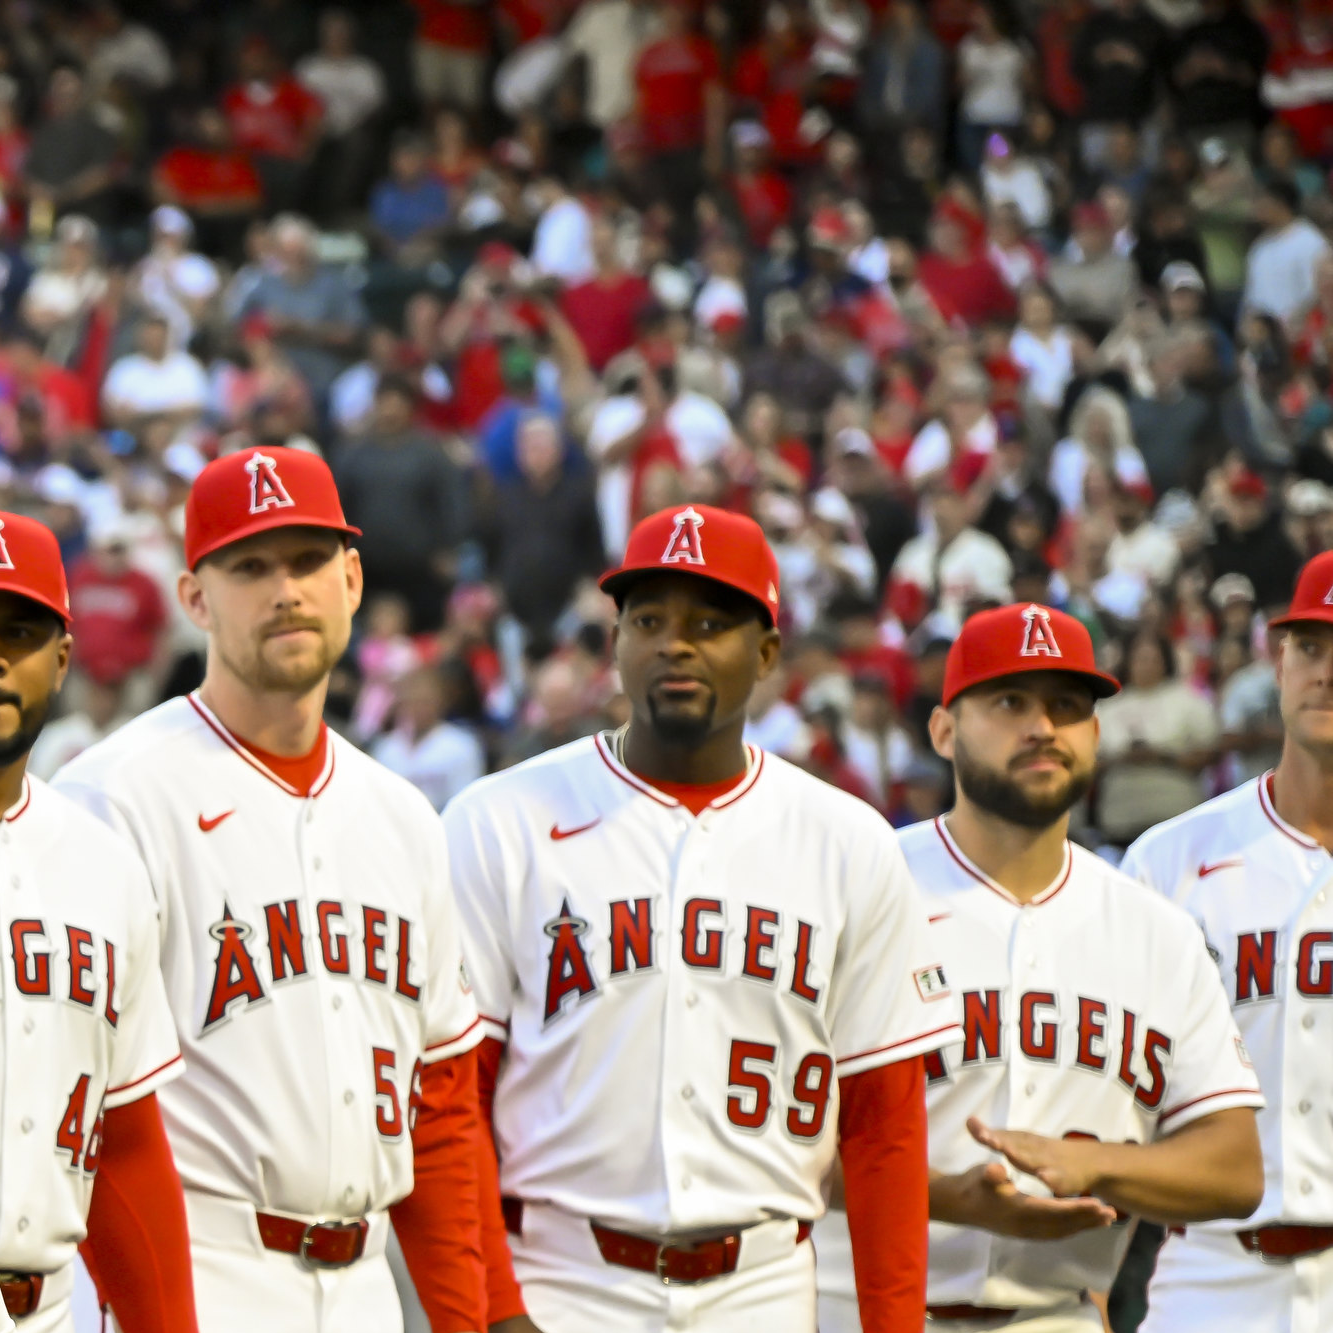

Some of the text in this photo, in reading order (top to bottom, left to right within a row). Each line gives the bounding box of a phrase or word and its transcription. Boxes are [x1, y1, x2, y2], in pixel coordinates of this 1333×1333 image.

[244, 451, 296, 515] A
[660, 506, 706, 567] A
[1020, 603, 1063, 659] A
[925, 988, 1174, 1112] NGELS
[726, 1038, 833, 1143] 59
